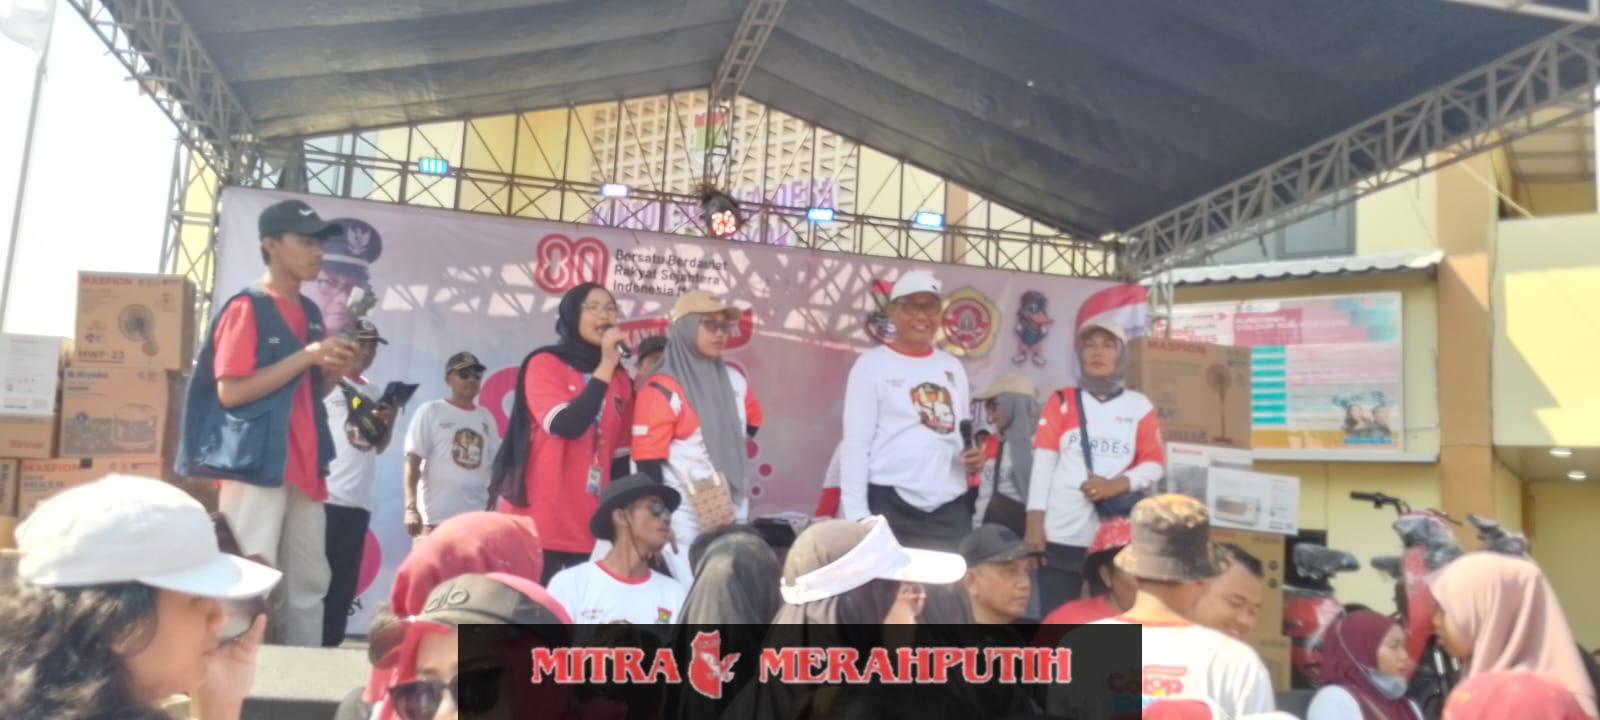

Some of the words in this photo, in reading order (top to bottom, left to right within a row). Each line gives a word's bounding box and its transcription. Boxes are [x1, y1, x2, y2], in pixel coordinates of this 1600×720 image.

[615, 249, 665, 265] Bersatu
[614, 265, 656, 281] Rakyat
[661, 269, 720, 285] Sejahtera
[613, 282, 675, 296] Indonesia
